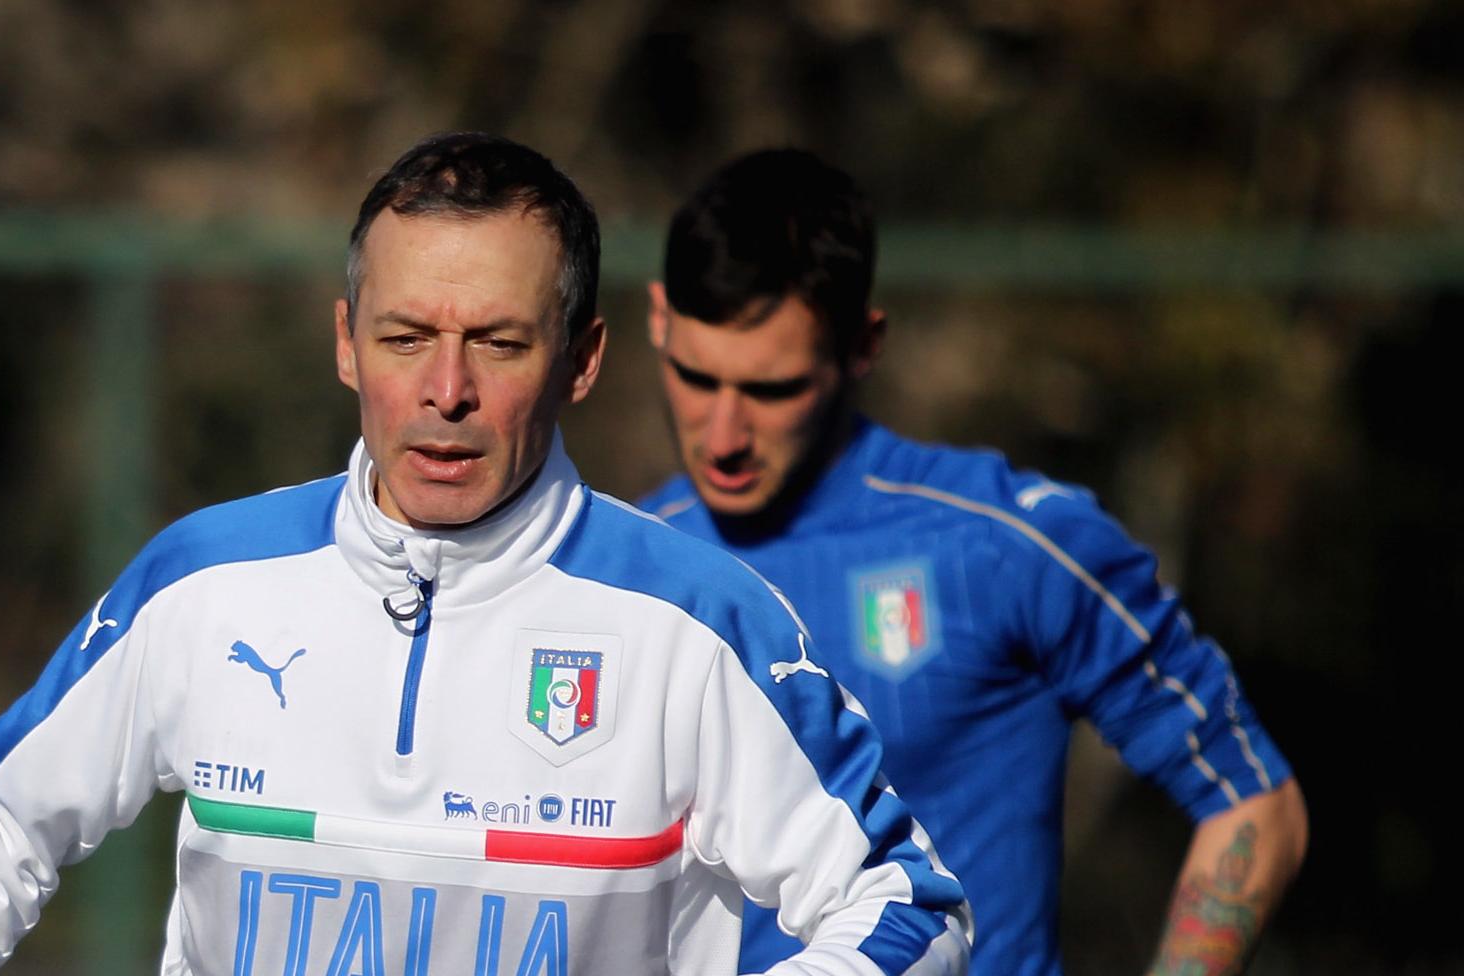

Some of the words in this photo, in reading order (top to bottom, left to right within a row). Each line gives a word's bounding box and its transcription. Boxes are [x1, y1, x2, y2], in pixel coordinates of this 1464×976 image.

[540, 653, 593, 666] ITALIA
[216, 763, 265, 795] TIM
[482, 795, 531, 825] eni
[571, 797, 617, 828] FIAT
